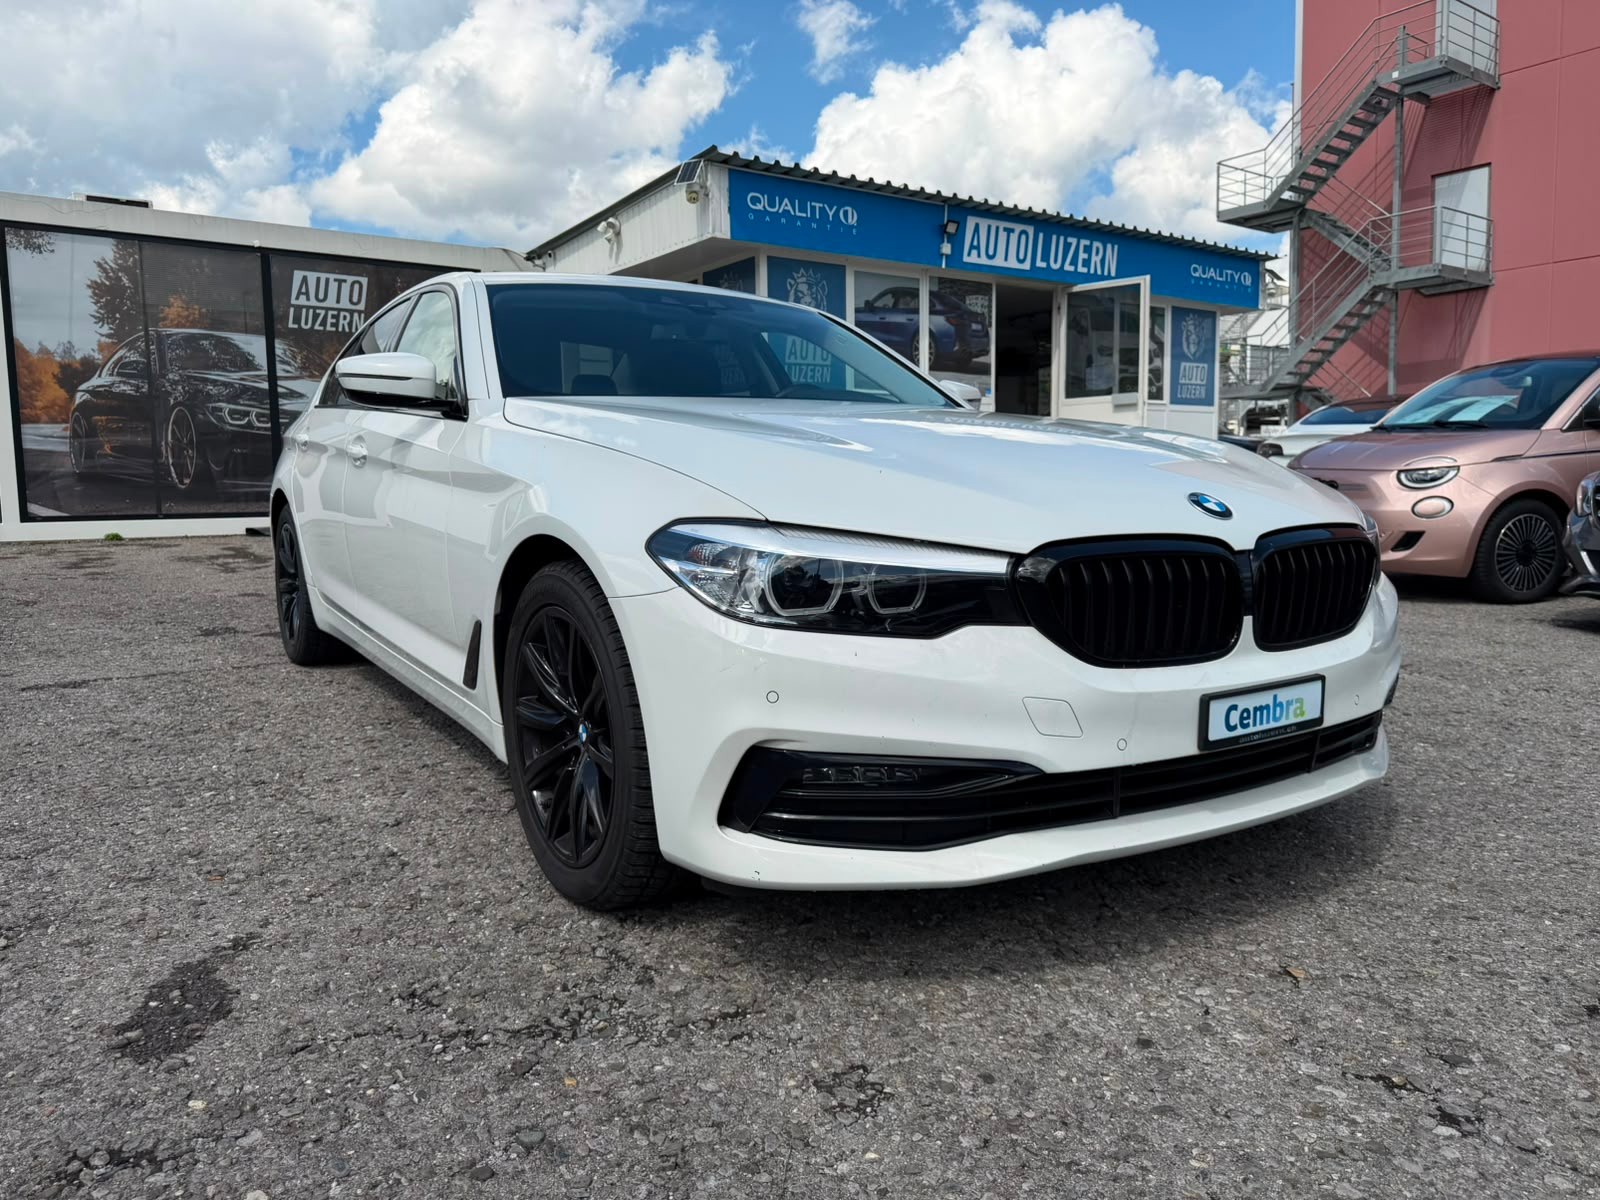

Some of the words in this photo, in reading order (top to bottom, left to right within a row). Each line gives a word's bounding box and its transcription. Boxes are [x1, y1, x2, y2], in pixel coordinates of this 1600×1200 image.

[967, 222, 1030, 264] AUTO
[1036, 232, 1118, 277] LUZERN
[295, 275, 364, 306] AUTO
[288, 307, 365, 332] LUZERN
[1180, 364, 1206, 383] AUTO
[1177, 384, 1206, 399] LUZERN
[1224, 694, 1305, 732] Cembra
